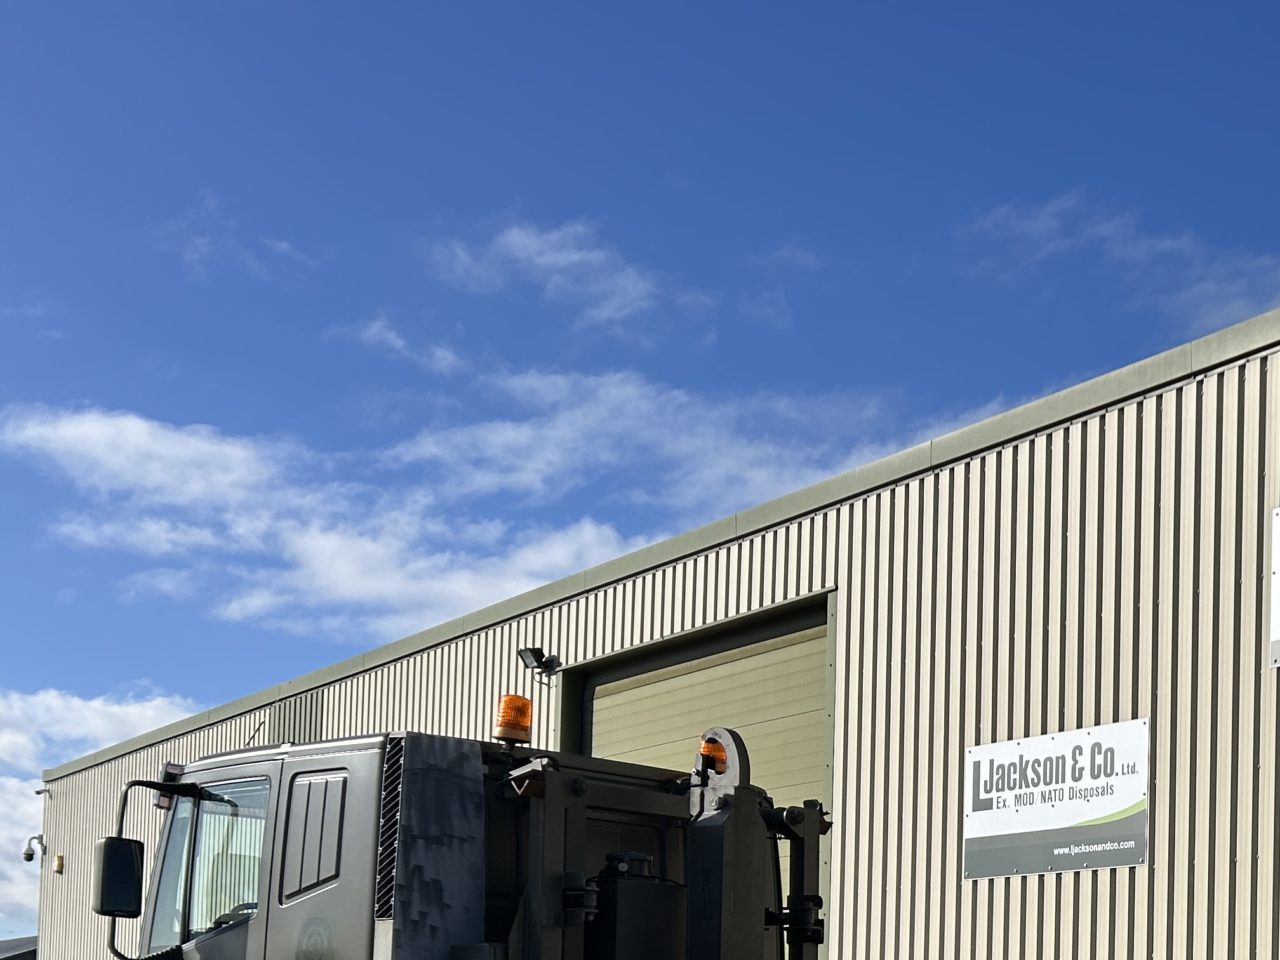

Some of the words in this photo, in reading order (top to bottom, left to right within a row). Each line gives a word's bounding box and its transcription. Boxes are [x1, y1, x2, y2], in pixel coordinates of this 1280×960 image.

[1071, 744, 1085, 783] &
[1089, 741, 1119, 780] Co.
[1121, 762, 1139, 776] Ltd.
[996, 796, 1010, 810] Ex.
[1014, 787, 1065, 808] MOD/NATO
[1068, 781, 1115, 801] Disposals
[1053, 839, 1136, 856] www.ljacksonandco.com
